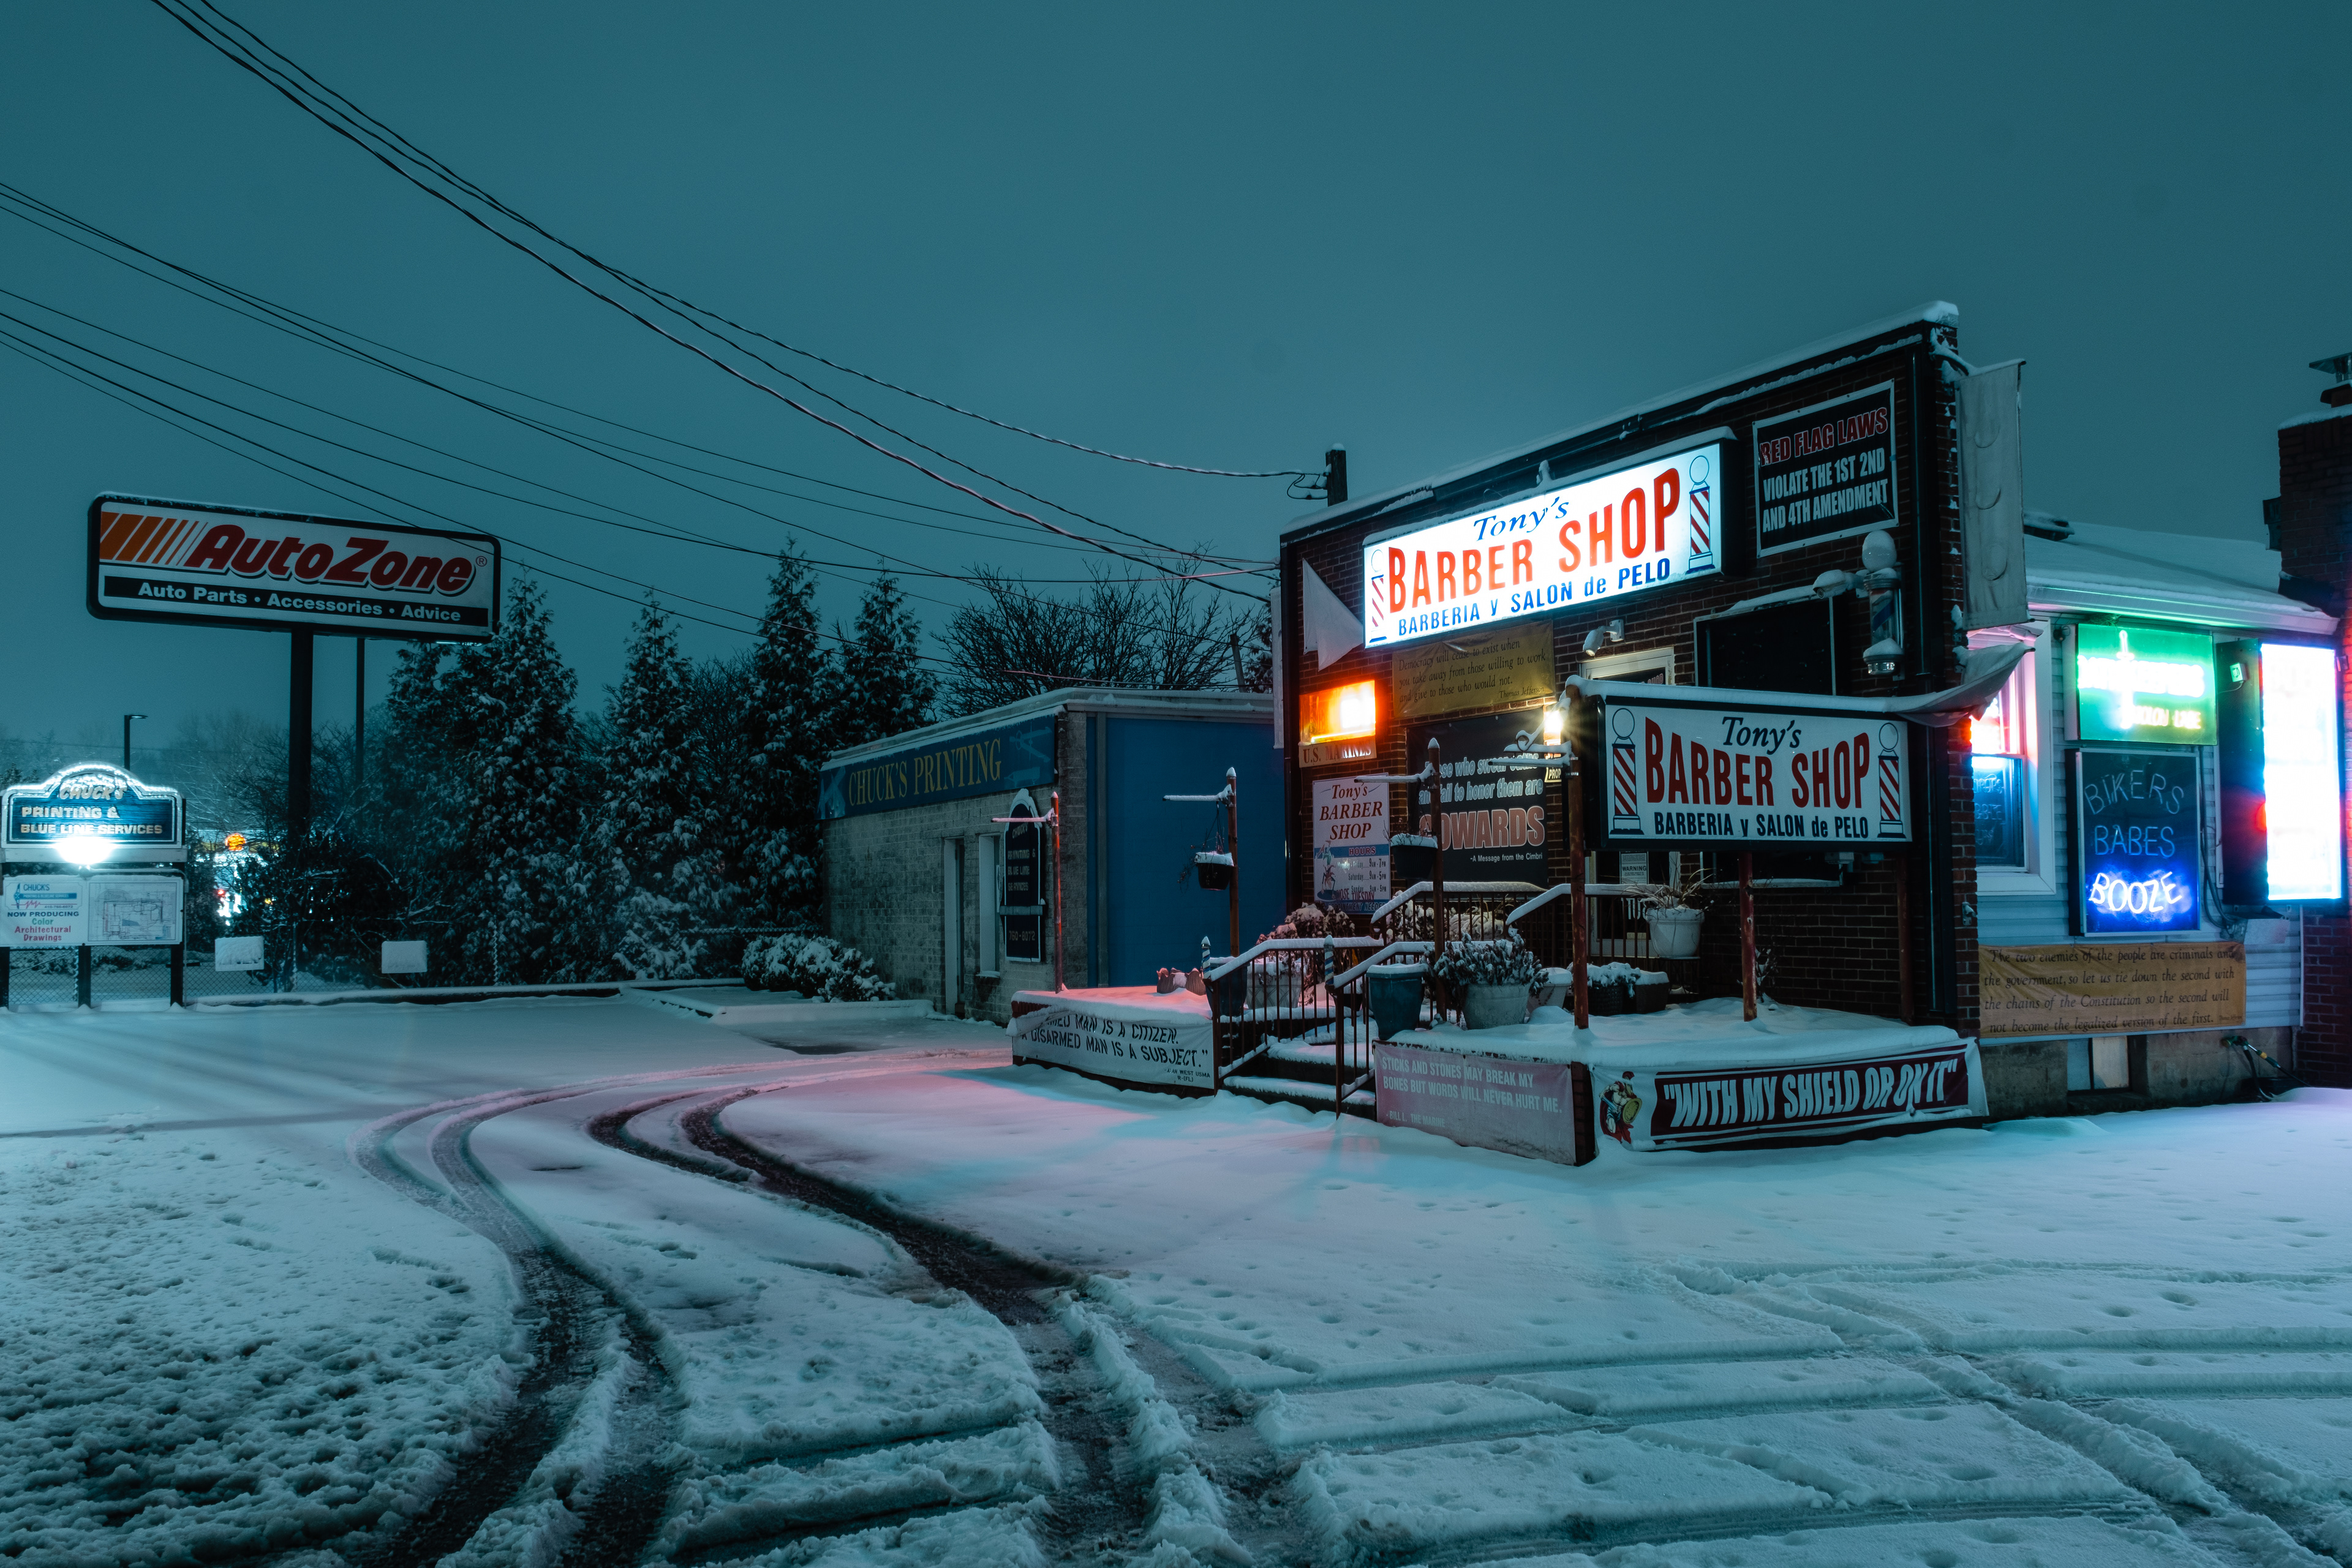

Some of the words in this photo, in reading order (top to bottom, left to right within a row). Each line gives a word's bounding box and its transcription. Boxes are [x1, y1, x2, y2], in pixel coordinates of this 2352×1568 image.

[1760, 437, 1791, 467] RED
[1794, 423, 1834, 458] FLAG
[1837, 407, 1888, 446] LAWS
[1763, 469, 1809, 502] VIOLATE
[1811, 462, 1832, 489] THE
[1834, 456, 1855, 483] 1ST
[1860, 448, 1885, 477] 2ND
[1763, 505, 1785, 533] AND
[1789, 499, 1811, 526] 4TH
[1813, 478, 1888, 520] AMENDMENT
[1389, 539, 1532, 614] BARBER
[1559, 468, 1680, 573] SHOP
[186, 524, 474, 592] AutoZone
[138, 582, 186, 599] Auto
[194, 587, 247, 605] Parts
[268, 594, 383, 614] Accessories
[401, 605, 461, 622] Advice
[1399, 603, 1480, 636] BARBERIA
[1511, 585, 1572, 612] SALON
[1585, 576, 1607, 595] de
[1619, 558, 1670, 589] PELO
[1399, 657, 1434, 671] Democracy
[1436, 650, 1449, 663] will
[1452, 650, 1469, 661] cease
[1482, 644, 1499, 655] exist
[1501, 638, 1520, 652] when
[1413, 673, 1427, 684] take
[1429, 671, 1447, 682] away
[1449, 666, 1465, 680] from
[1468, 662, 1485, 674] those
[1488, 657, 1513, 670] willing
[1528, 649, 1546, 663] work
[1400, 690, 1411, 703] and
[1414, 690, 1427, 702] give
[1439, 683, 1455, 696] those
[1458, 680, 1471, 693] who
[1475, 675, 1495, 690] would
[1499, 676, 1513, 687] not.
[1500, 689, 1520, 699] Thomas
[1521, 686, 1545, 699] Jefferson
[914, 737, 1001, 795] PRINTING
[1303, 747, 1321, 764] U.S.
[1325, 744, 1371, 761] MARINES
[1645, 716, 1774, 806] BARBER
[1792, 733, 1869, 810] SHOP
[1454, 783, 1465, 802] to
[1466, 781, 1495, 801] honor
[1497, 778, 1523, 798] them
[1525, 778, 1544, 796] are
[2085, 770, 2184, 815] BIKERS
[22, 806, 102, 818] PRINTING
[107, 806, 120, 818] &
[1319, 801, 1382, 821] BARBER
[1654, 812, 1733, 835] BARBERIA
[1757, 814, 1805, 837] SALON
[1812, 816, 1828, 838] de
[1834, 816, 1868, 839] PELO
[21, 824, 56, 834] BLUE
[61, 824, 95, 834] LINE
[98, 824, 163, 834] SERVICES
[1330, 823, 1372, 840] SHOP
[2095, 825, 2176, 859] BABES
[1349, 846, 1376, 856] HOURS
[1008, 882, 1028, 891] SERVICES
[2089, 871, 2182, 914] BOOZE
[1990, 949, 2010, 962] The
[2016, 954, 2035, 962] two
[2040, 951, 2078, 962] enemies
[2118, 948, 2146, 963] people
[2169, 946, 2213, 960] criminals
[2005, 975, 2066, 989] government,
[2132, 970, 2157, 982] down
[2180, 967, 2210, 981] second
[2215, 966, 2234, 979] with
[2006, 996, 2040, 1009] chains
[2081, 994, 2141, 1007] Constitution
[2178, 989, 2207, 1003] second
[2212, 989, 2230, 1001] will
[1076, 1014, 1098, 1033] MAN
[1102, 1019, 1114, 1035] IS
[1118, 1025, 1126, 1038] A
[1131, 1023, 1178, 1044] CITIZEN.
[2011, 1019, 2049, 1032] become
[2075, 1015, 2117, 1033] legalized
[2123, 1016, 2154, 1028] version
[2192, 1011, 2214, 1027] first.
[1031, 1028, 1081, 1049] DISARMED
[1086, 1035, 1108, 1055] MAN
[1112, 1041, 1123, 1057] IS
[1129, 1044, 1137, 1060] A
[1382, 1056, 1409, 1073] STICKS
[1412, 1060, 1428, 1076] AND
[1430, 1062, 1461, 1079] STONES
[1463, 1066, 1483, 1082] MAY
[1486, 1069, 1515, 1087] BREAK
[1518, 1072, 1534, 1088] MY
[1383, 1076, 1408, 1093] BONES
[1411, 1079, 1426, 1094] BUT
[1428, 1082, 1458, 1099] WORDS
[1460, 1086, 1482, 1102] WILL
[1483, 1088, 1513, 1107] NEVER
[1515, 1093, 1540, 1111] HURT
[1543, 1096, 1562, 1114] ME.
[1743, 1076, 1777, 1124] MY
[1782, 1069, 1861, 1119] SHIELD
[1863, 1066, 1894, 1110] OR
[1895, 1063, 1929, 1108] ON
[1389, 1111, 1401, 1121] BILL
[1411, 1114, 1422, 1125] THE
[1423, 1115, 1446, 1128] MARINE
